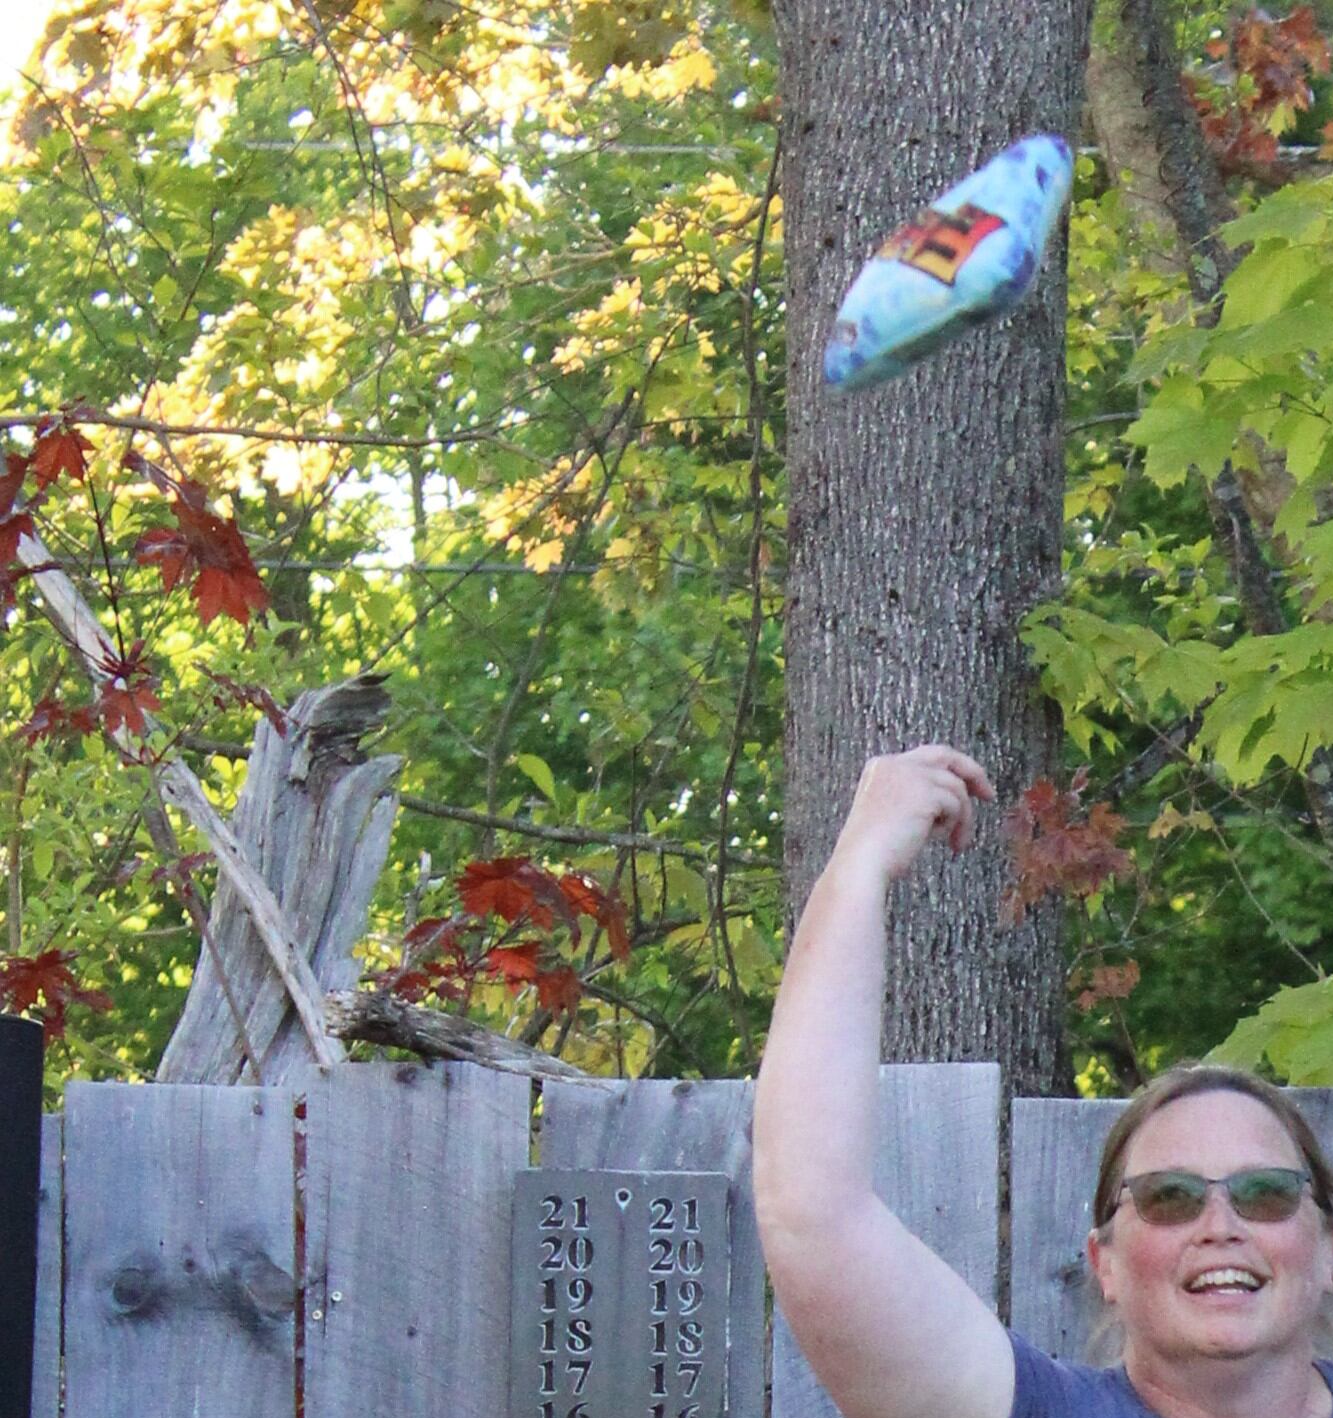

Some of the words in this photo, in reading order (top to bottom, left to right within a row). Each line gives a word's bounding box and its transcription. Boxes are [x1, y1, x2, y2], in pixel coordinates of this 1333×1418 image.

[539, 1195, 590, 1229] 21
[650, 1197, 701, 1232] 21
[539, 1237, 594, 1271] 20
[649, 1238, 706, 1274] 20
[539, 1278, 594, 1313] 19
[650, 1280, 704, 1315] 19
[539, 1319, 593, 1354] 18
[650, 1320, 704, 1356] 18
[539, 1360, 592, 1394] 17
[650, 1361, 703, 1397] 17
